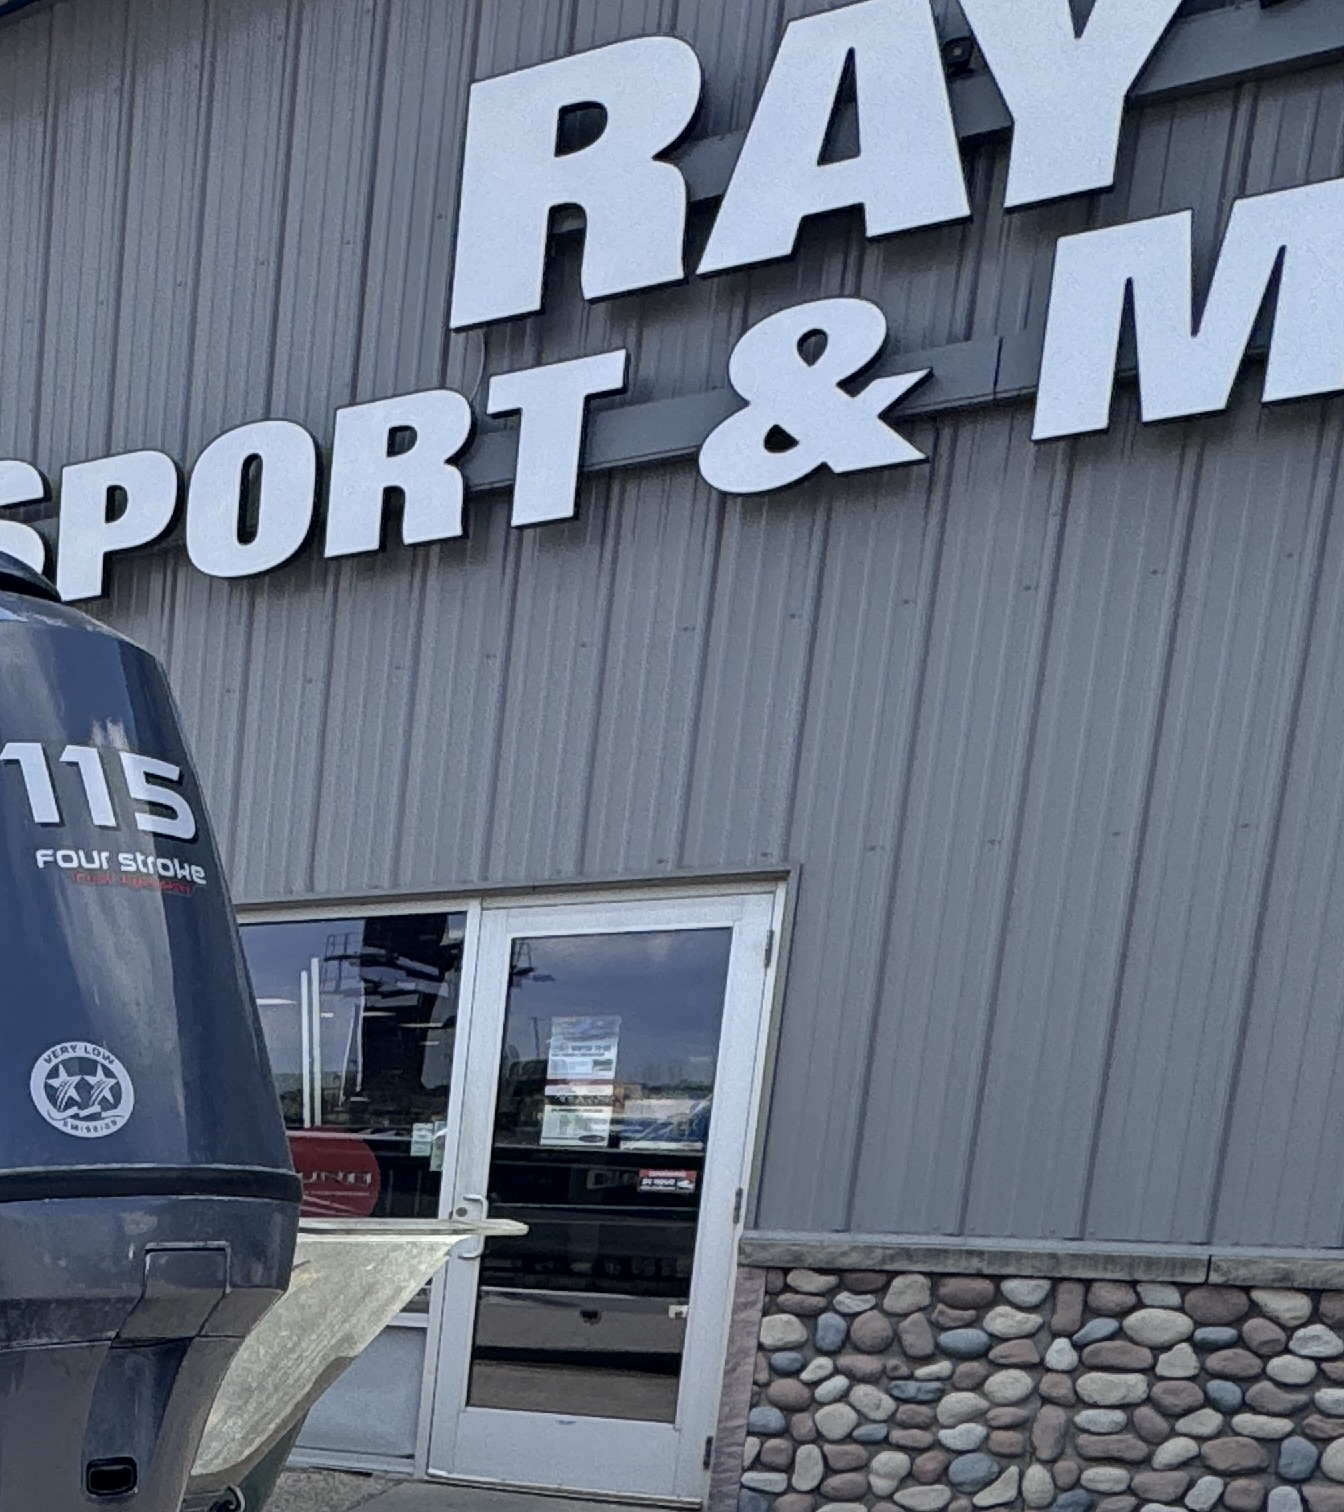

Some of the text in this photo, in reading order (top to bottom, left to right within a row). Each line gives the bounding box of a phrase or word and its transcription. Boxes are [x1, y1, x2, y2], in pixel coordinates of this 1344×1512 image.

[449, 0, 1183, 331] RAY
[697, 296, 930, 494] &
[43, 1044, 116, 1065] VERY LOW
